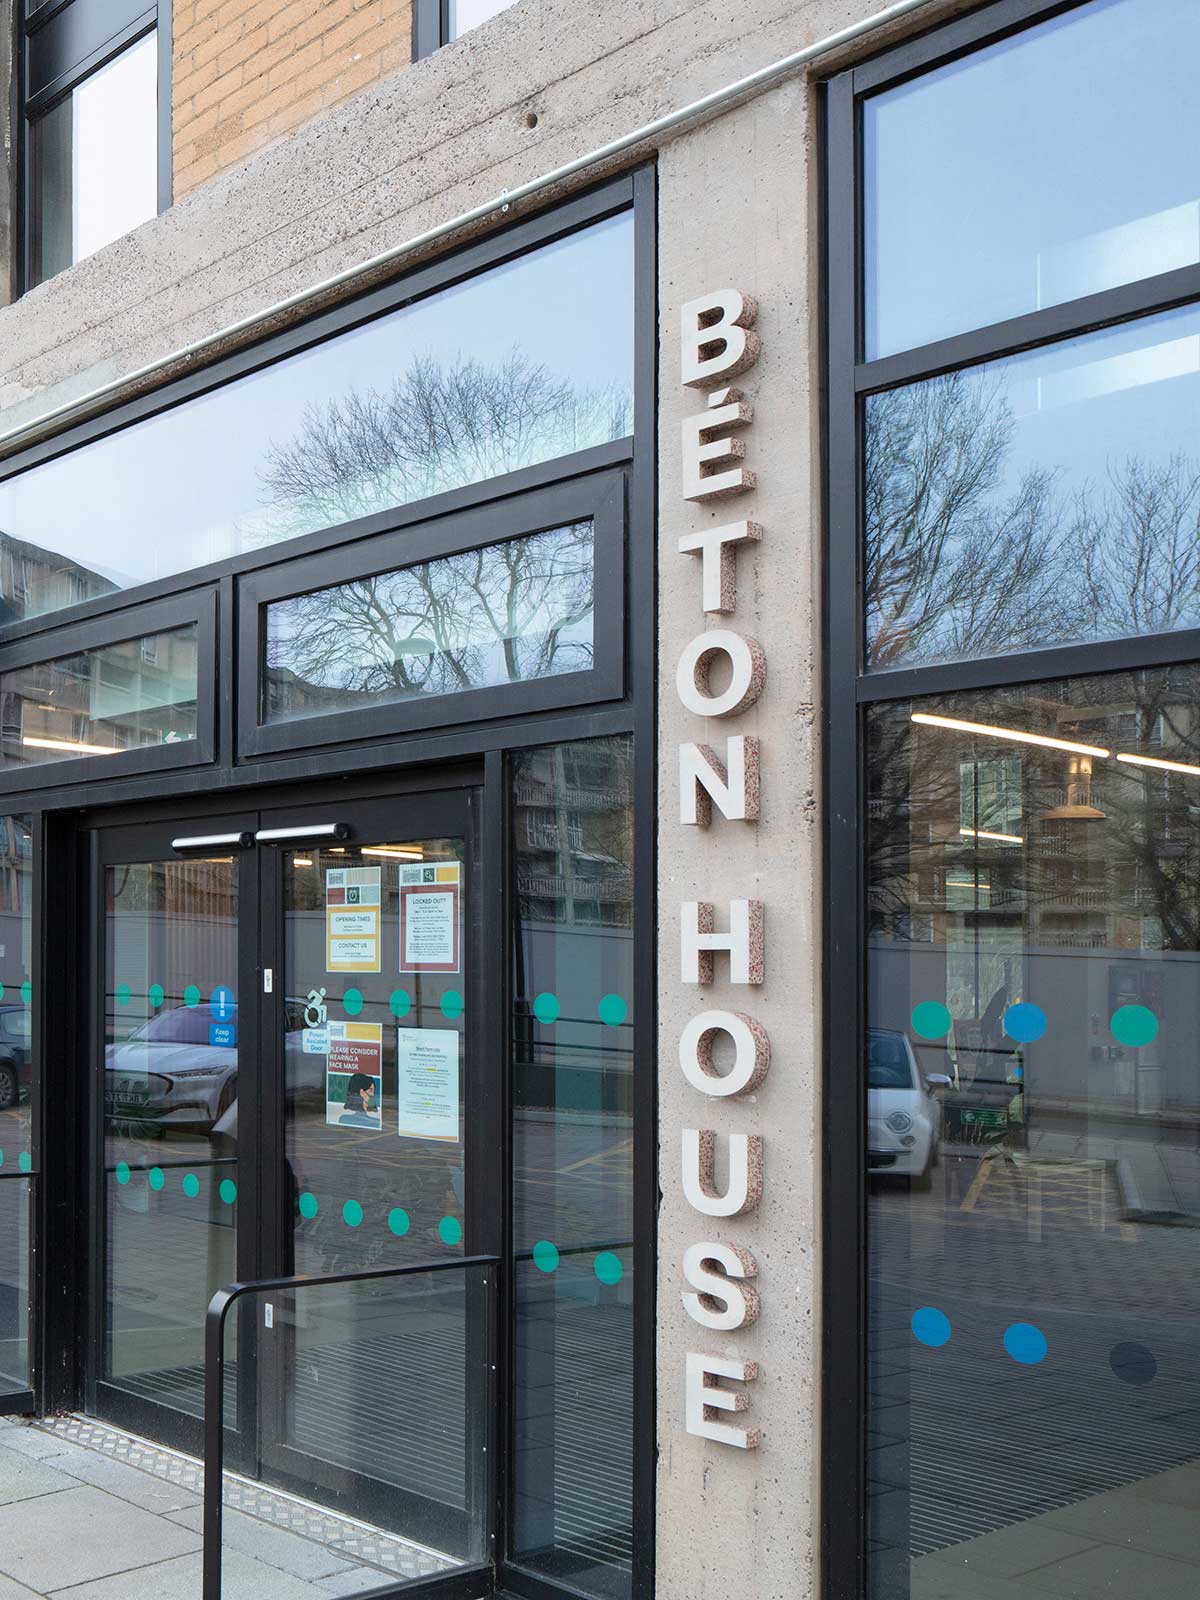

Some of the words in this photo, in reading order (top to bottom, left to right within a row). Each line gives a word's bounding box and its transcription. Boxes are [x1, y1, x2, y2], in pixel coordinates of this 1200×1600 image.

[676, 288, 766, 826] BÉTON
[215, 1028, 229, 1037] Keep
[215, 1035, 229, 1043] clear
[350, 1047, 378, 1056] CONSIDER
[329, 1054, 354, 1062] WEARING
[678, 898, 770, 1449] HOUSE
